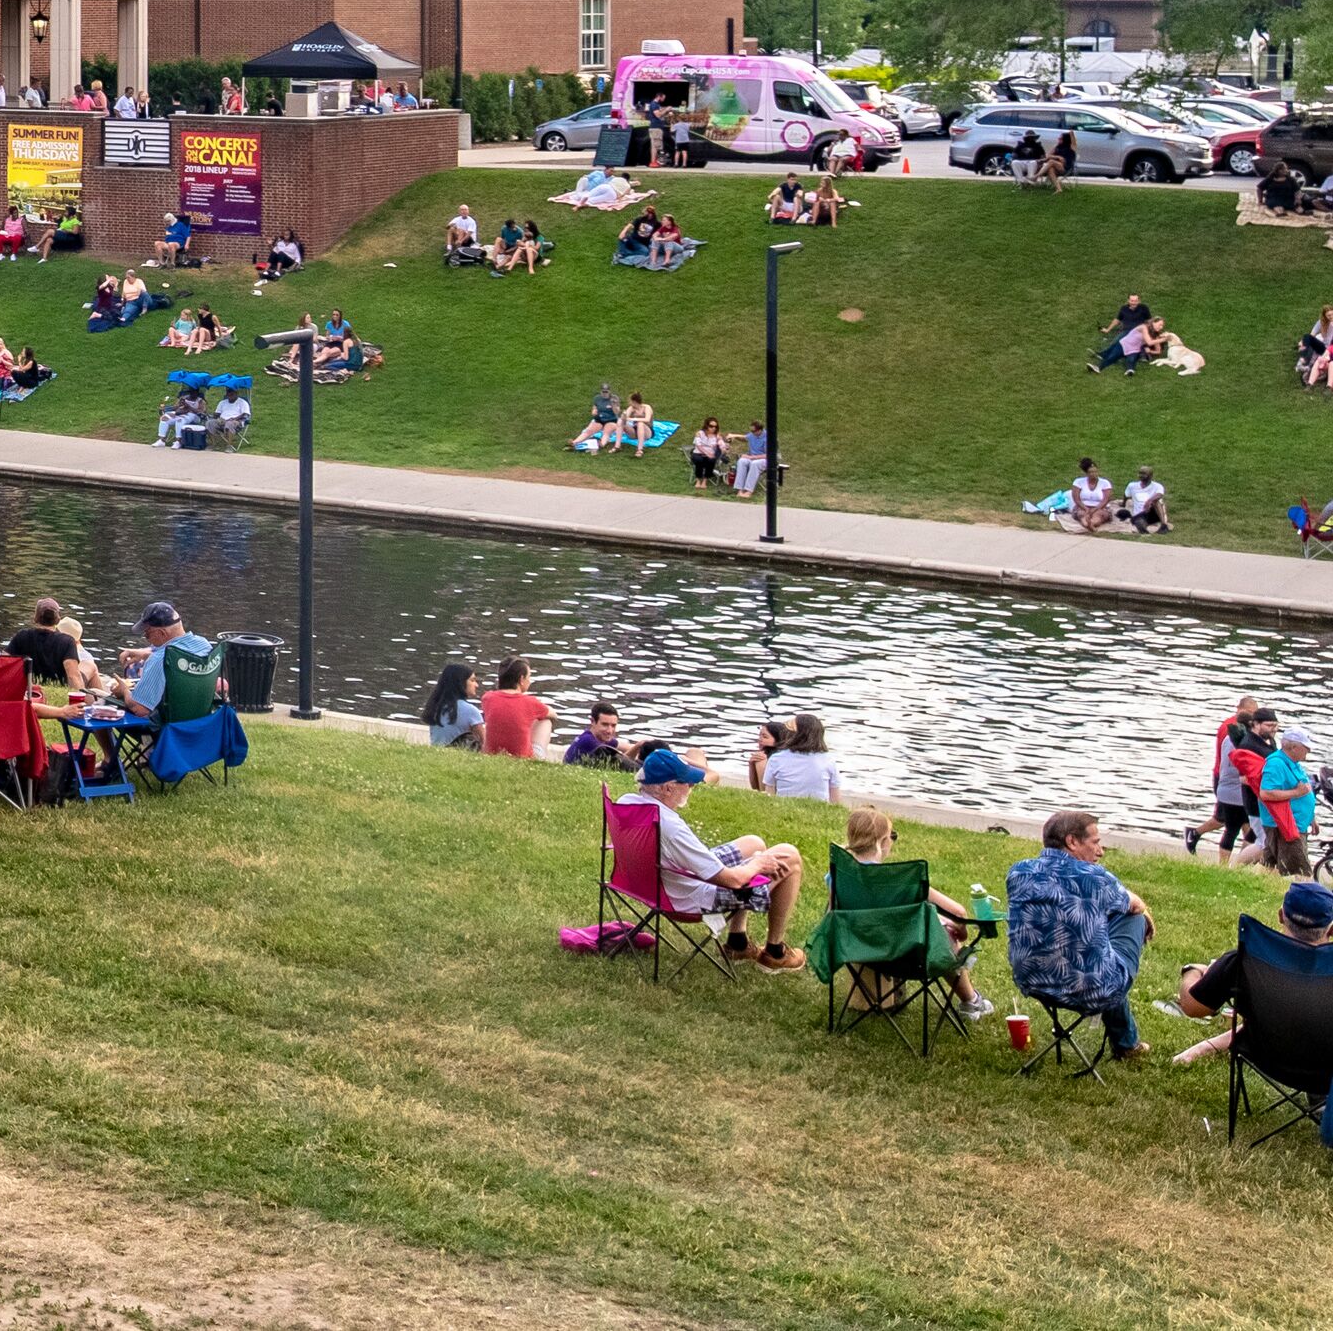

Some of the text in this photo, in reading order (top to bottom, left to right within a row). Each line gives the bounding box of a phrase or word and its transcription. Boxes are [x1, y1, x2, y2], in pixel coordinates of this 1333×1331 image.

[12, 128, 79, 141] SUMMER FUN!
[12, 140, 79, 151] FREE ADMISSION
[184, 136, 257, 152] CONCERTS
[13, 149, 79, 161] THURSDAYS
[185, 155, 199, 163] THE
[198, 149, 256, 167] CANAL
[184, 165, 202, 173] 2018
[202, 166, 228, 174] LINEUP
